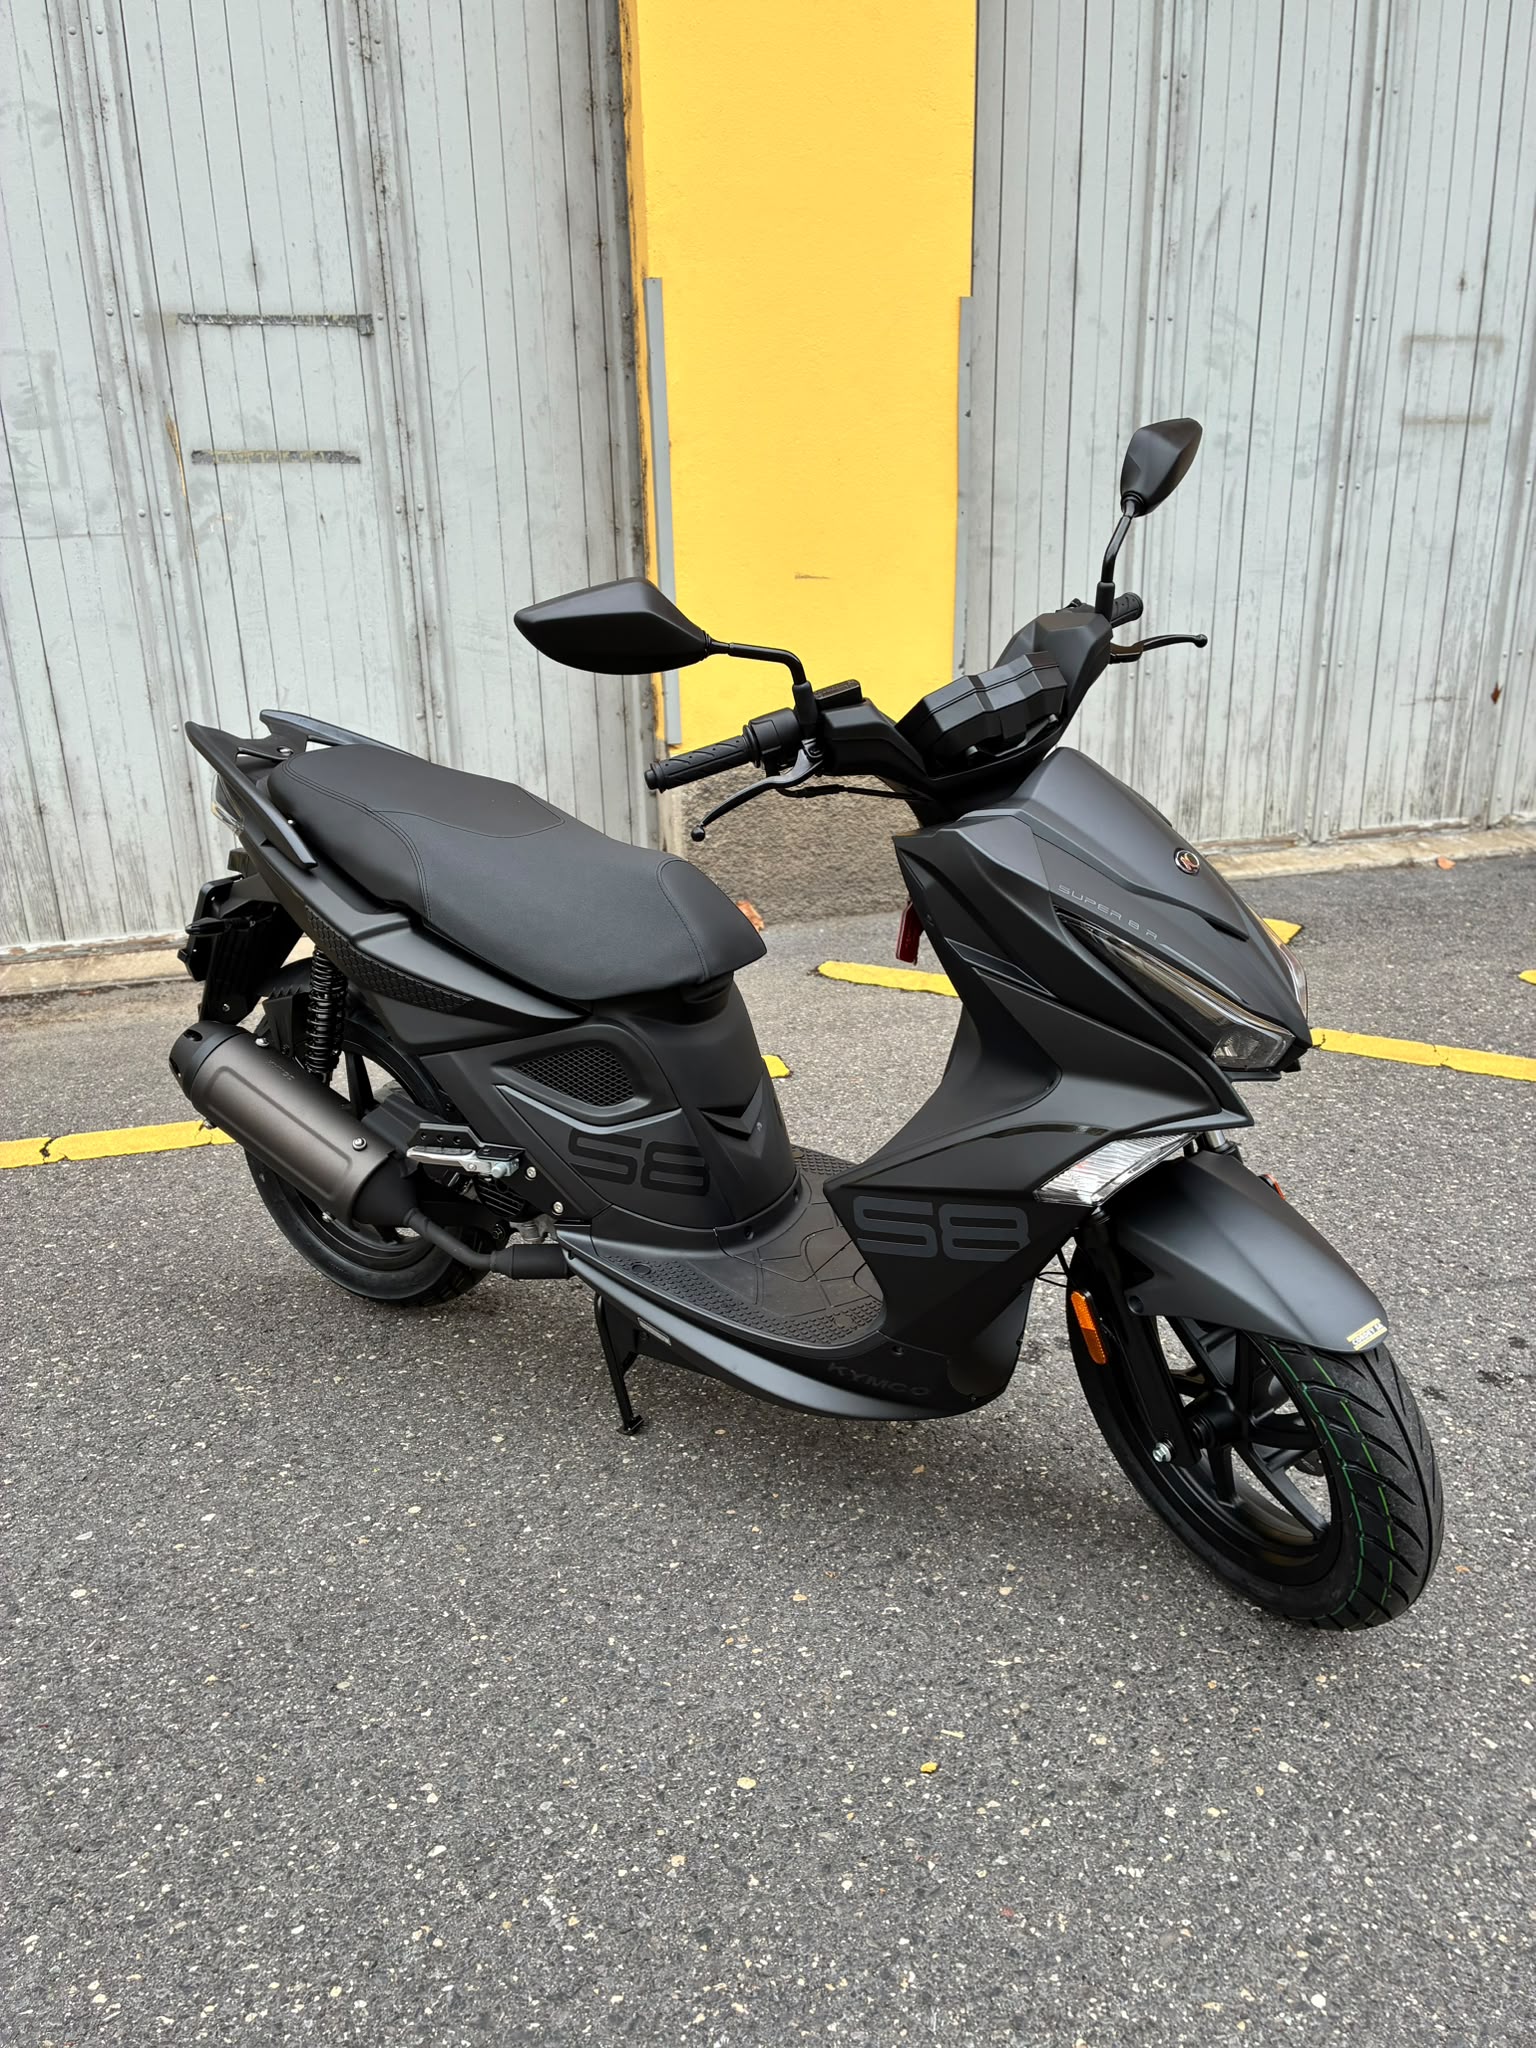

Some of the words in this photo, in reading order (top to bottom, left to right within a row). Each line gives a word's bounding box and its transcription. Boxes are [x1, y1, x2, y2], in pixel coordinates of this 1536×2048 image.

[1058, 885, 1122, 920] SUPER
[1128, 920, 1140, 930] 8
[1146, 930, 1157, 940] R
[568, 1127, 711, 1197] S8
[852, 1195, 1032, 1263] S8
[827, 1362, 931, 1396] KYMCO
